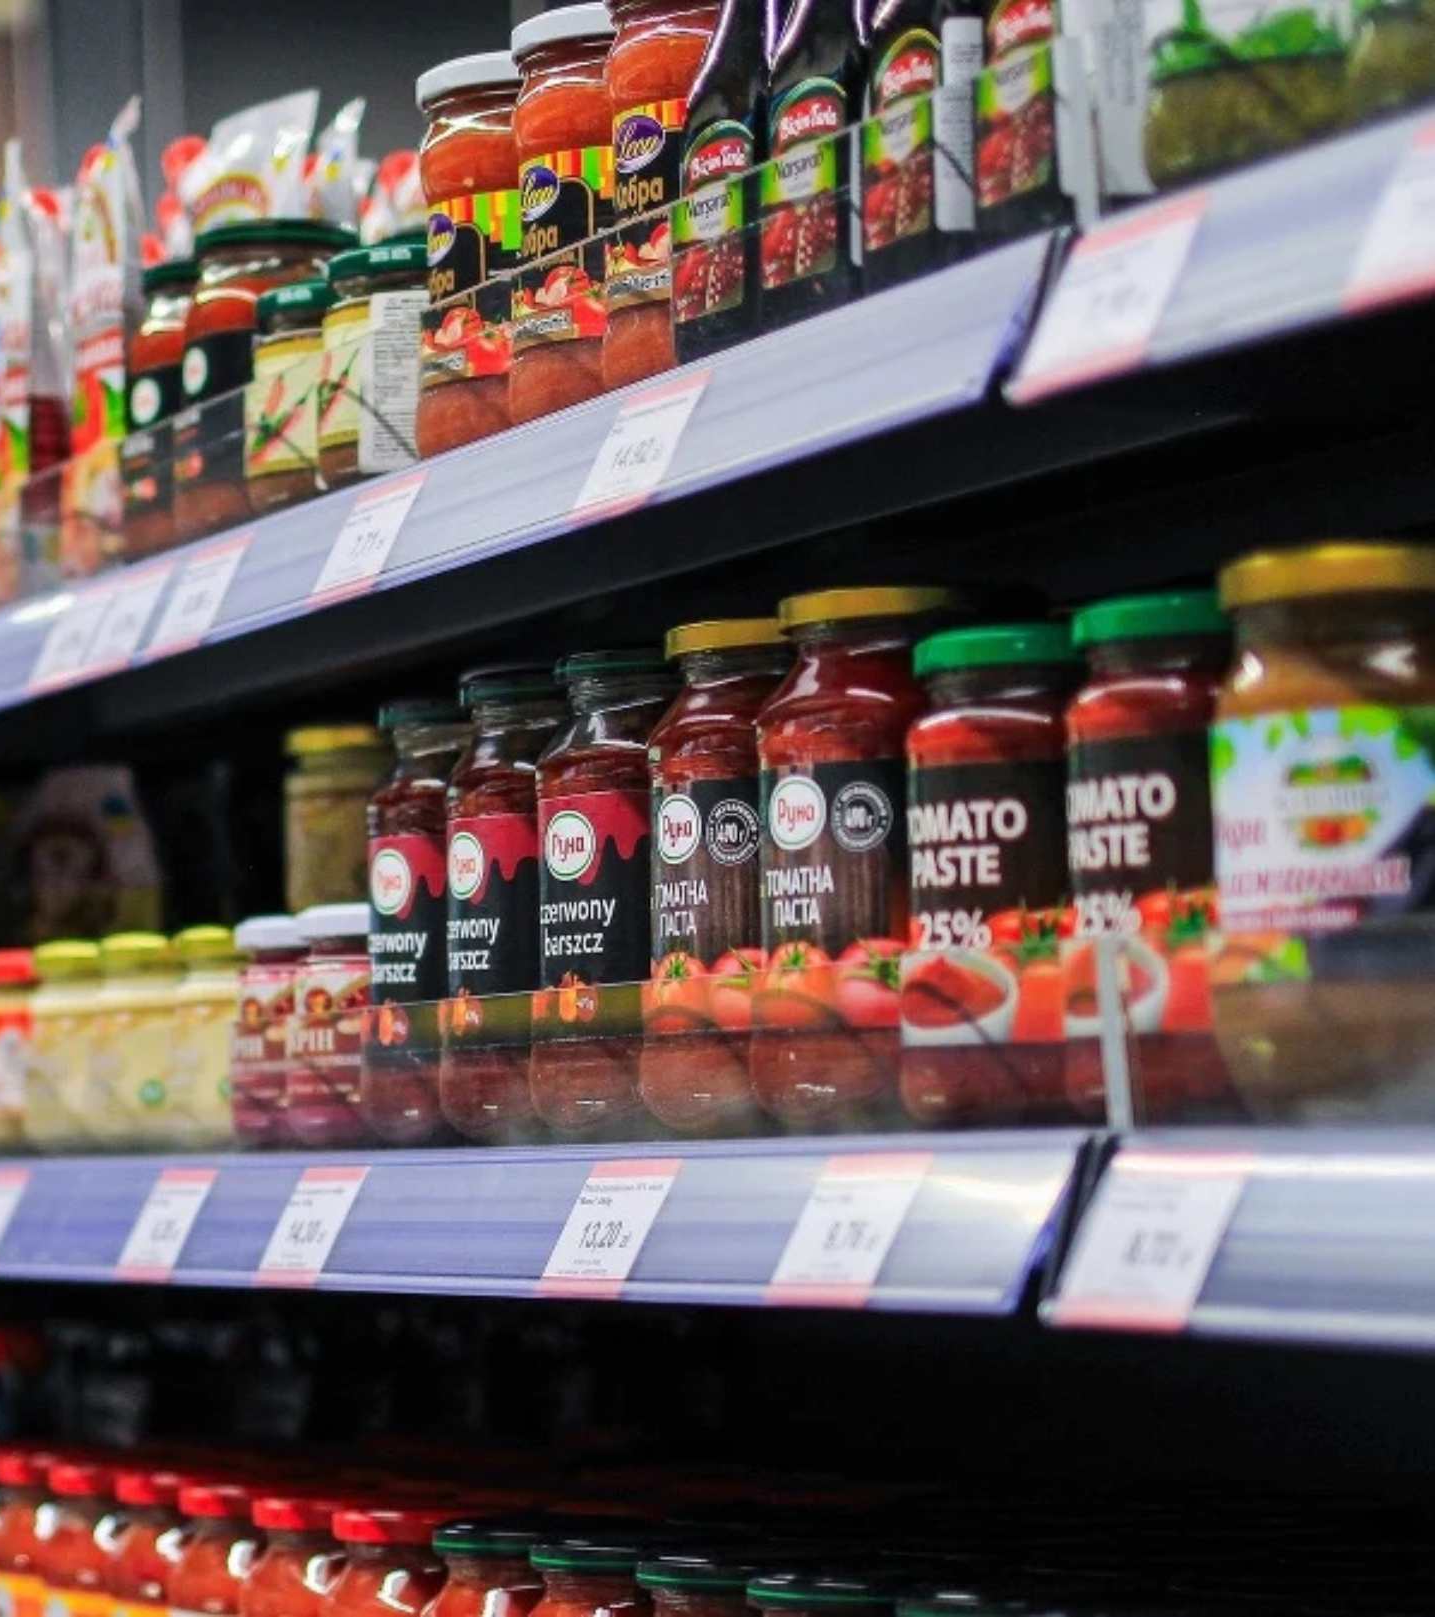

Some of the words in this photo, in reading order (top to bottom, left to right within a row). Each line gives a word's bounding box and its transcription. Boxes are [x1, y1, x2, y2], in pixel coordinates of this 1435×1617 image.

[662, 815, 692, 848] Руна
[777, 798, 814, 832] Руна
[907, 799, 1028, 845] OMATO
[551, 834, 584, 862] Руна
[765, 864, 835, 897] ТОМАТНА
[911, 845, 1002, 888] PASTE
[660, 910, 697, 937] ПАСТА
[773, 898, 821, 927] ПАСТА
[919, 906, 992, 950] 25%
[544, 932, 604, 956] barszcz
[578, 1220, 623, 1250] 13,20
